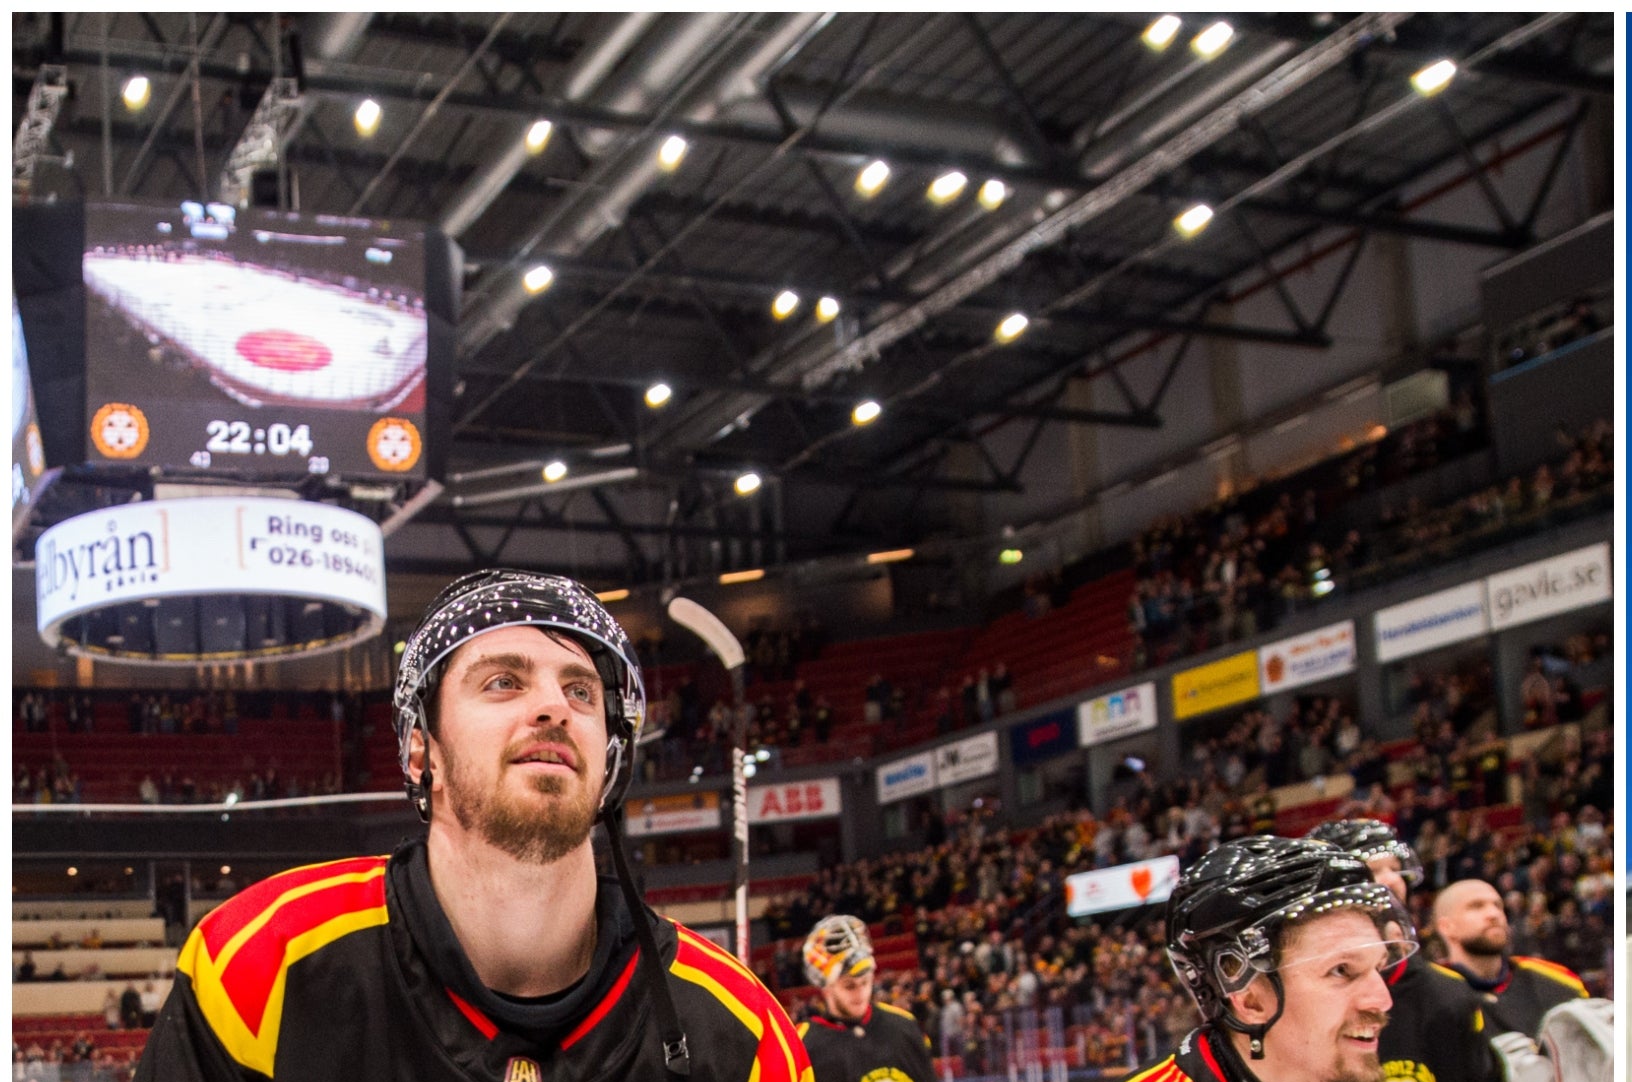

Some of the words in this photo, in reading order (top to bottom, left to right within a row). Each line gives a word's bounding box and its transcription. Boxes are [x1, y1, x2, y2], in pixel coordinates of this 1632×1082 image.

[206, 419, 314, 456] 22:04
[267, 515, 323, 544] Ring
[331, 528, 360, 548] oss
[760, 786, 825, 818] ABB
